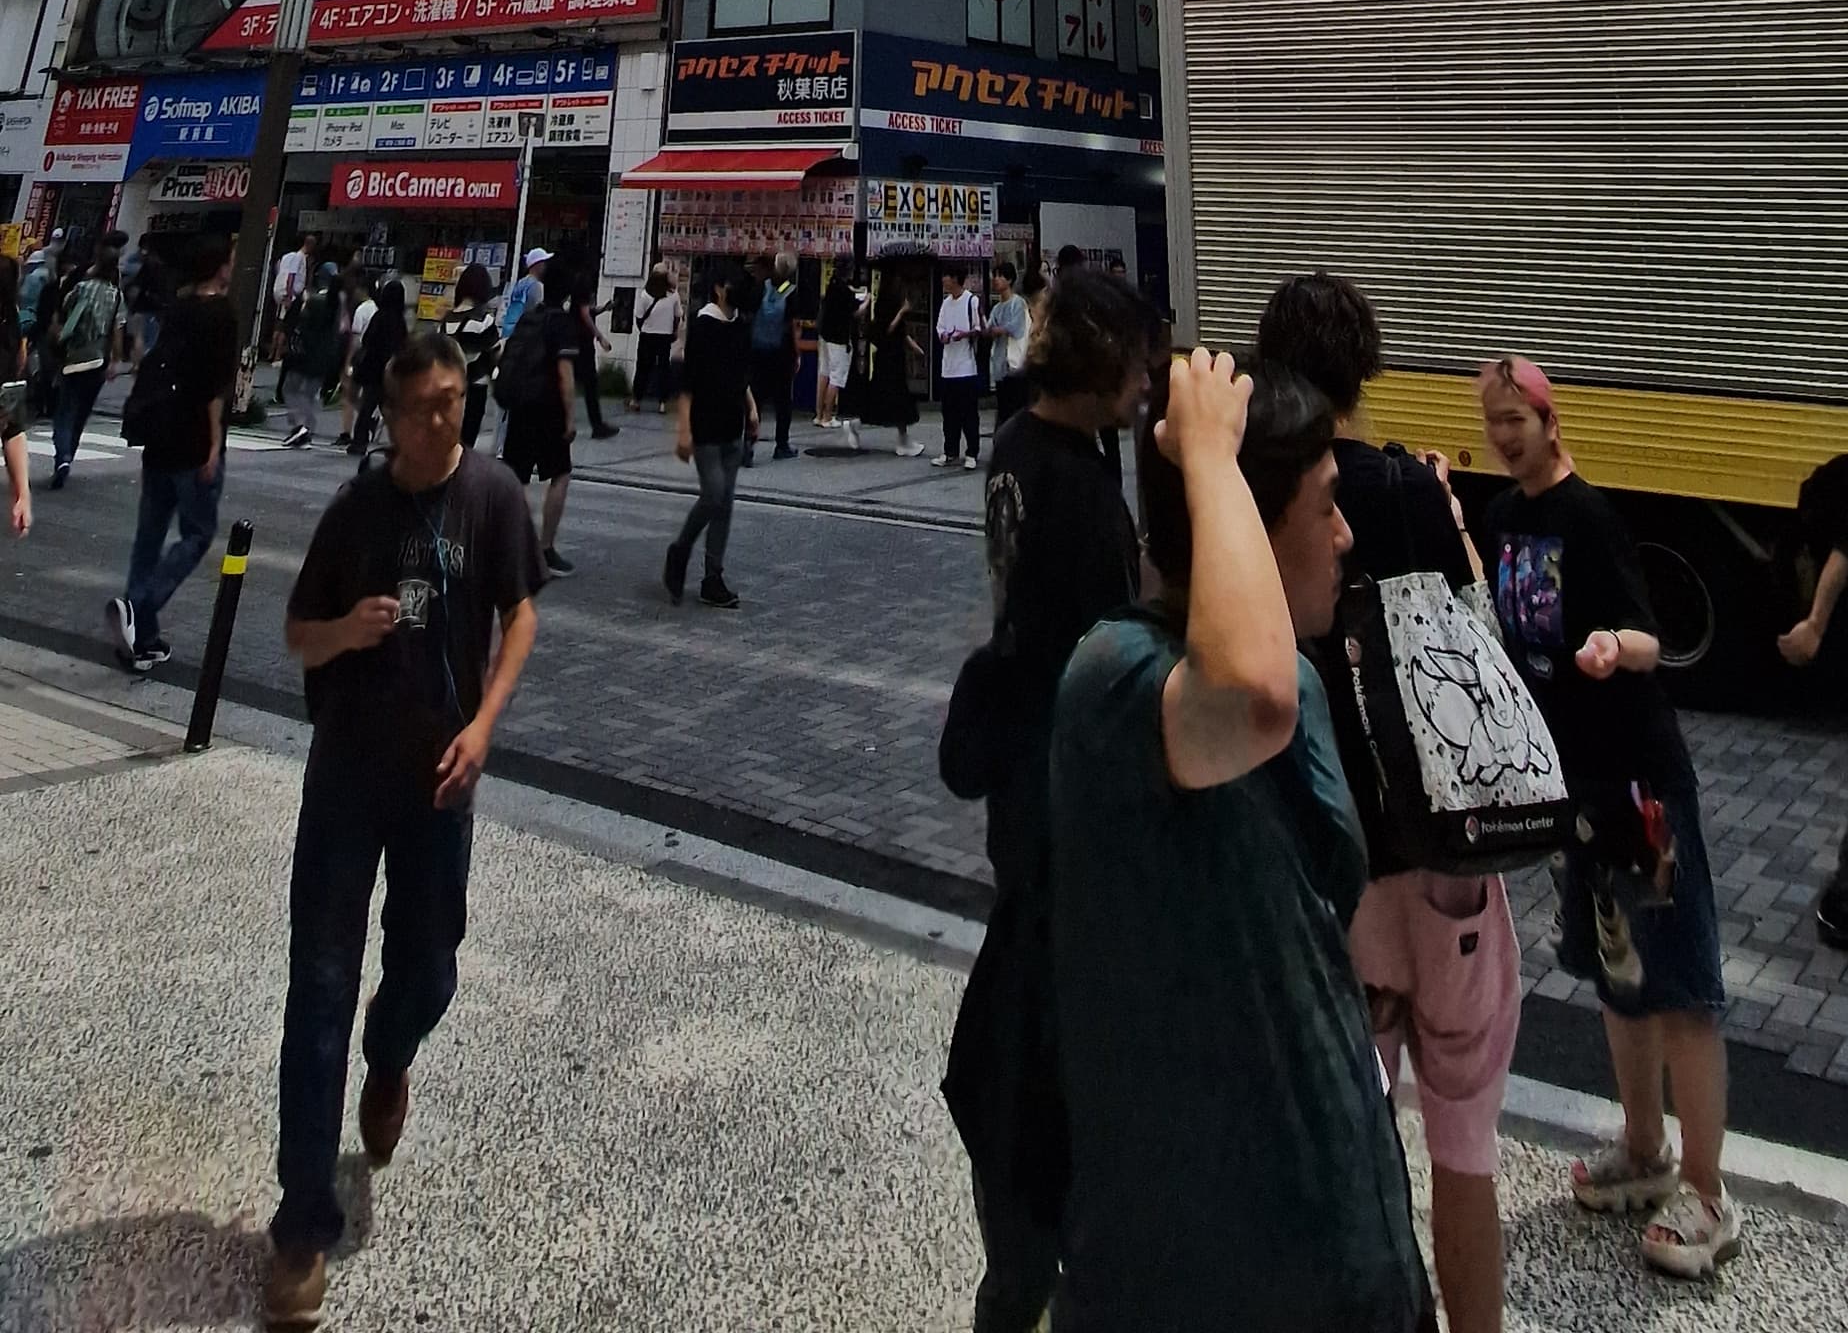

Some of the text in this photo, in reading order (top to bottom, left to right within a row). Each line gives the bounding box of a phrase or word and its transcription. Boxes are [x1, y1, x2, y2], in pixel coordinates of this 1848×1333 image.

[329, 59, 577, 96] 1F 2F 3F 4F 5F
[777, 76, 849, 102] 秋葉原店
[76, 85, 140, 110] TAX FREE
[160, 95, 260, 123] Sofmap AKIBA
[429, 117, 450, 130] テレビ
[776, 110, 846, 126] ACCESS TICKET
[888, 113, 963, 136] ACCESS TICKET
[427, 132, 463, 145] レコーダー
[486, 131, 516, 144] エアコン
[367, 171, 502, 199] BicCamera OUTLET
[883, 183, 992, 215] EXCHANGE
[1525, 815, 1555, 832] Center
